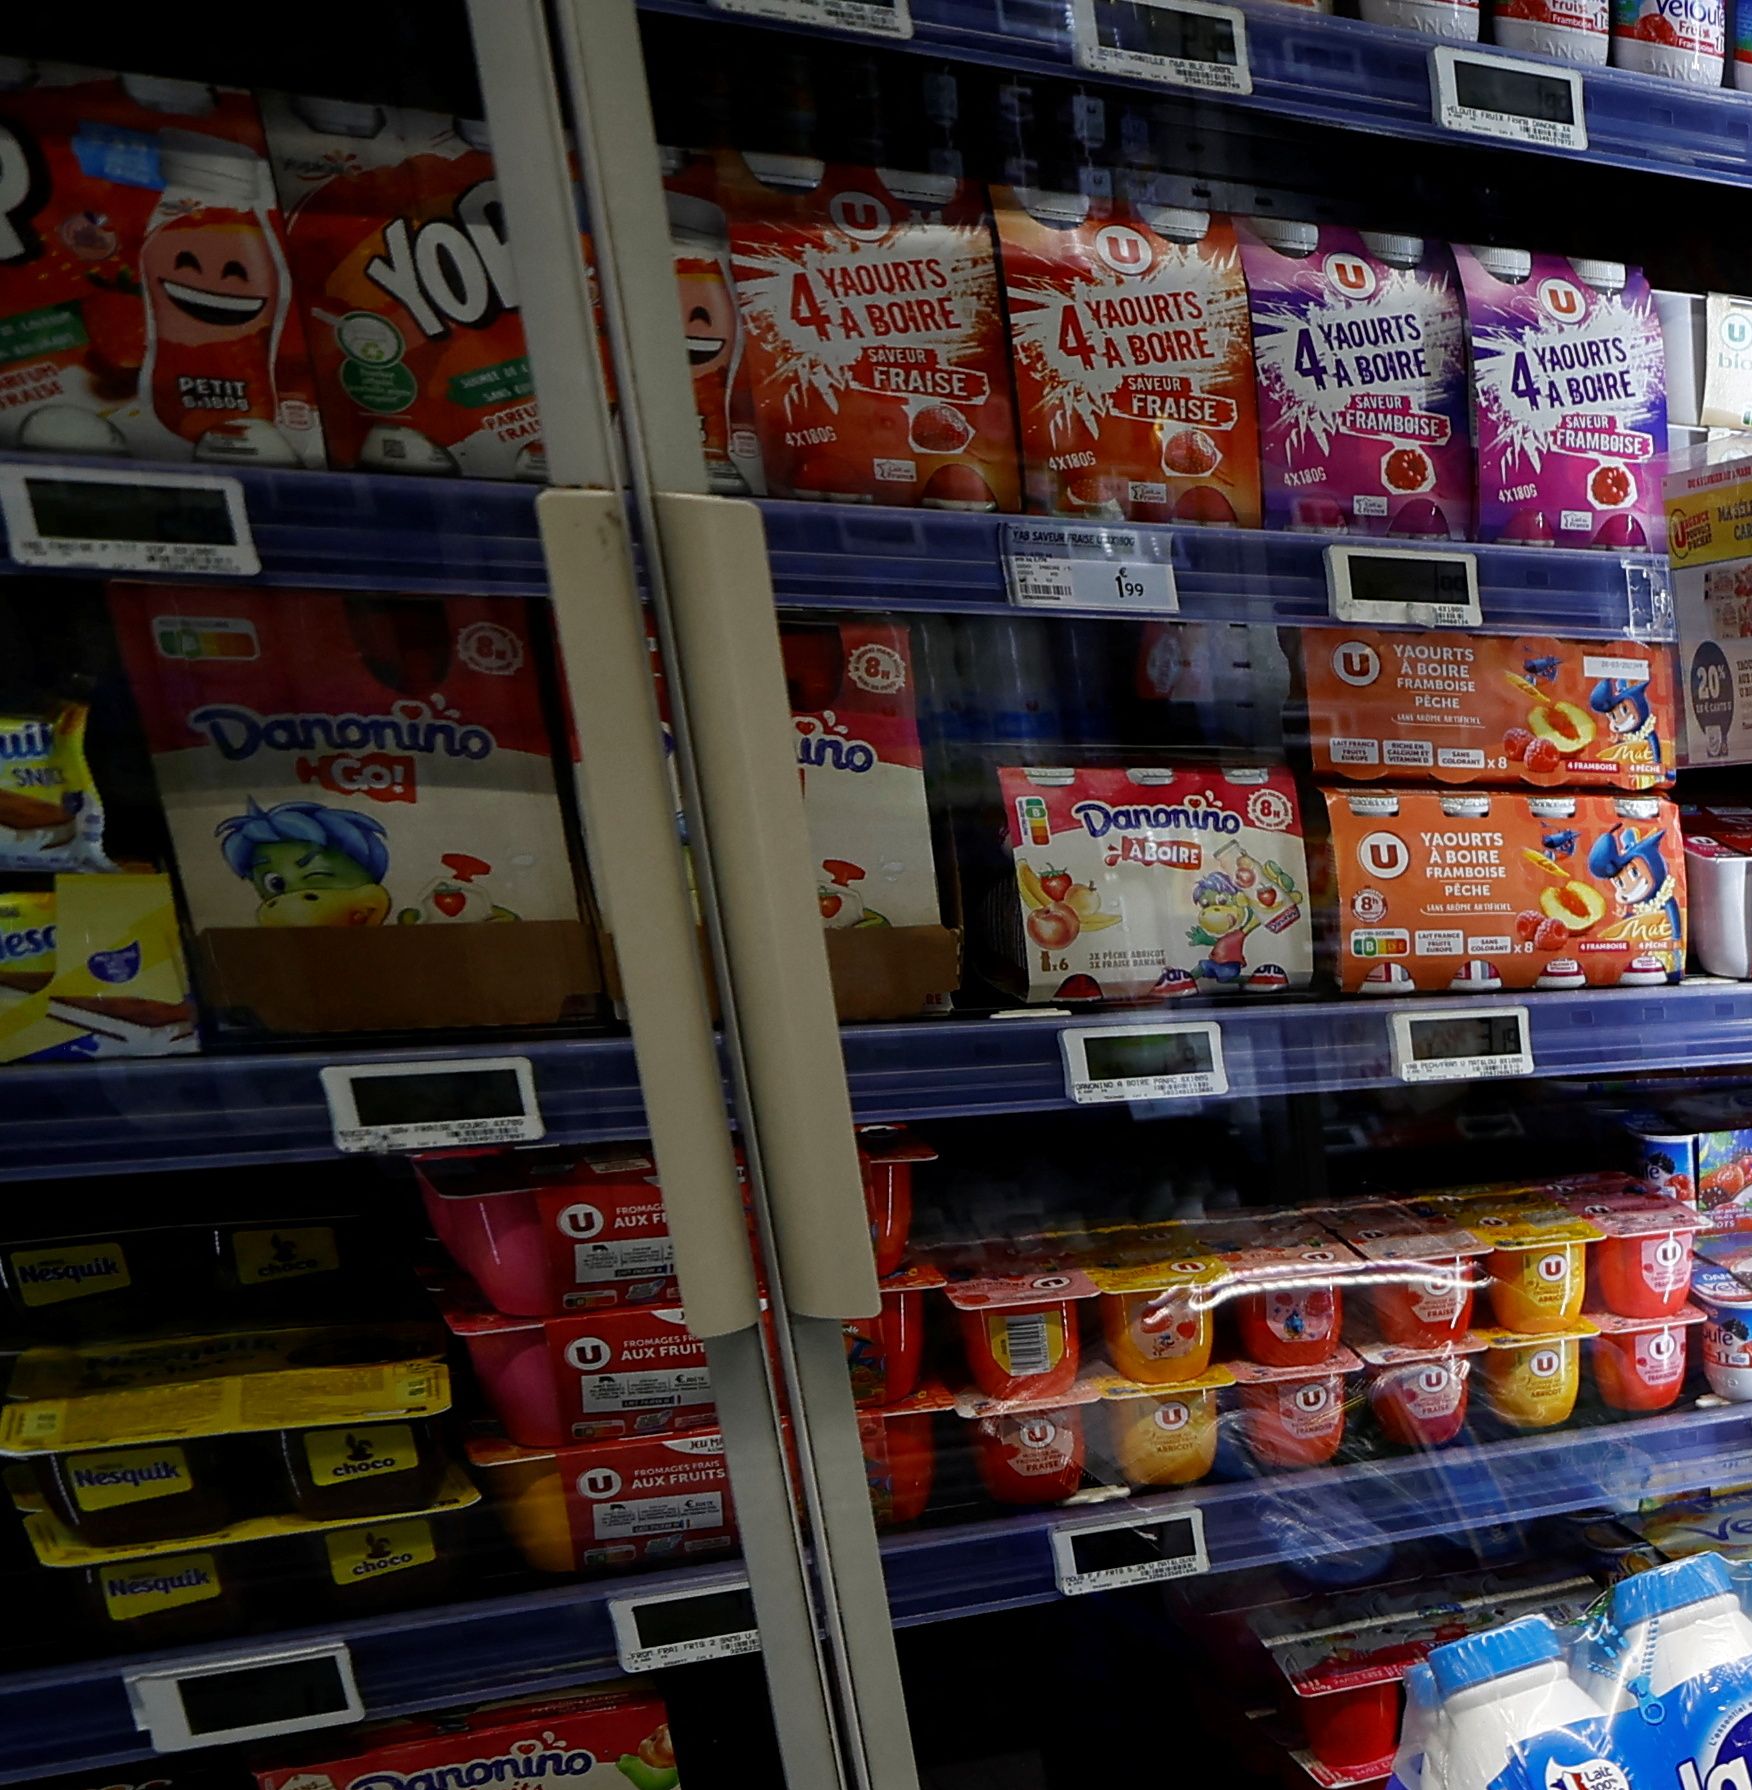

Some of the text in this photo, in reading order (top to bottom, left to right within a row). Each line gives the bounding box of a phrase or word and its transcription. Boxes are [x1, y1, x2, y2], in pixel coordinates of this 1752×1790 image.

[790, 259, 947, 341] 4 YAOURTS
[1058, 291, 1203, 371] 4 YAOURTS
[868, 348, 927, 365] SAVEUR
[1295, 313, 1422, 389] 4 YAOURTS
[872, 366, 967, 396] FRAISE
[1128, 375, 1182, 392] SAVEUR
[1511, 338, 1627, 410] 4 YAOURTS
[179, 377, 247, 398] PETIT
[1131, 392, 1218, 422] FRAISE
[1355, 396, 1404, 411] SAVEUR
[1346, 409, 1440, 438] FRAMBOISE
[1566, 416, 1609, 429] SAVEUR
[1556, 429, 1644, 456] FRAMBOISE
[1119, 567, 1128, 578] €
[1393, 644, 1475, 662] YAOURTS
[1401, 659, 1470, 678] À BOIRE
[1396, 677, 1477, 693] FRAMBOISE
[1414, 692, 1461, 709] PÊCHE
[194, 706, 493, 760] Danonino
[330, 757, 407, 792] Go!
[1074, 803, 1242, 838] Danonino
[1420, 832, 1504, 848] YAOURTS
[1429, 847, 1500, 865] À BOIRE
[1425, 866, 1506, 879] FRAMBOISE
[1444, 880, 1491, 897] PÊCHE
[613, 1212, 648, 1229] AUX
[20, 1257, 121, 1288] Nesquik
[258, 1255, 319, 1278] choco
[623, 1337, 672, 1348] FROMAGES
[73, 1459, 182, 1490] Nesquik
[332, 1455, 396, 1480] choco
[633, 1459, 721, 1477] FROMAGES FRAIS
[1026, 1458, 1060, 1473] FRAISE
[631, 1467, 726, 1490] AUX FRUITS
[352, 1551, 415, 1579] choco
[108, 1564, 212, 1597] Nesquik
[1584, 1766, 1613, 1785] Lait
